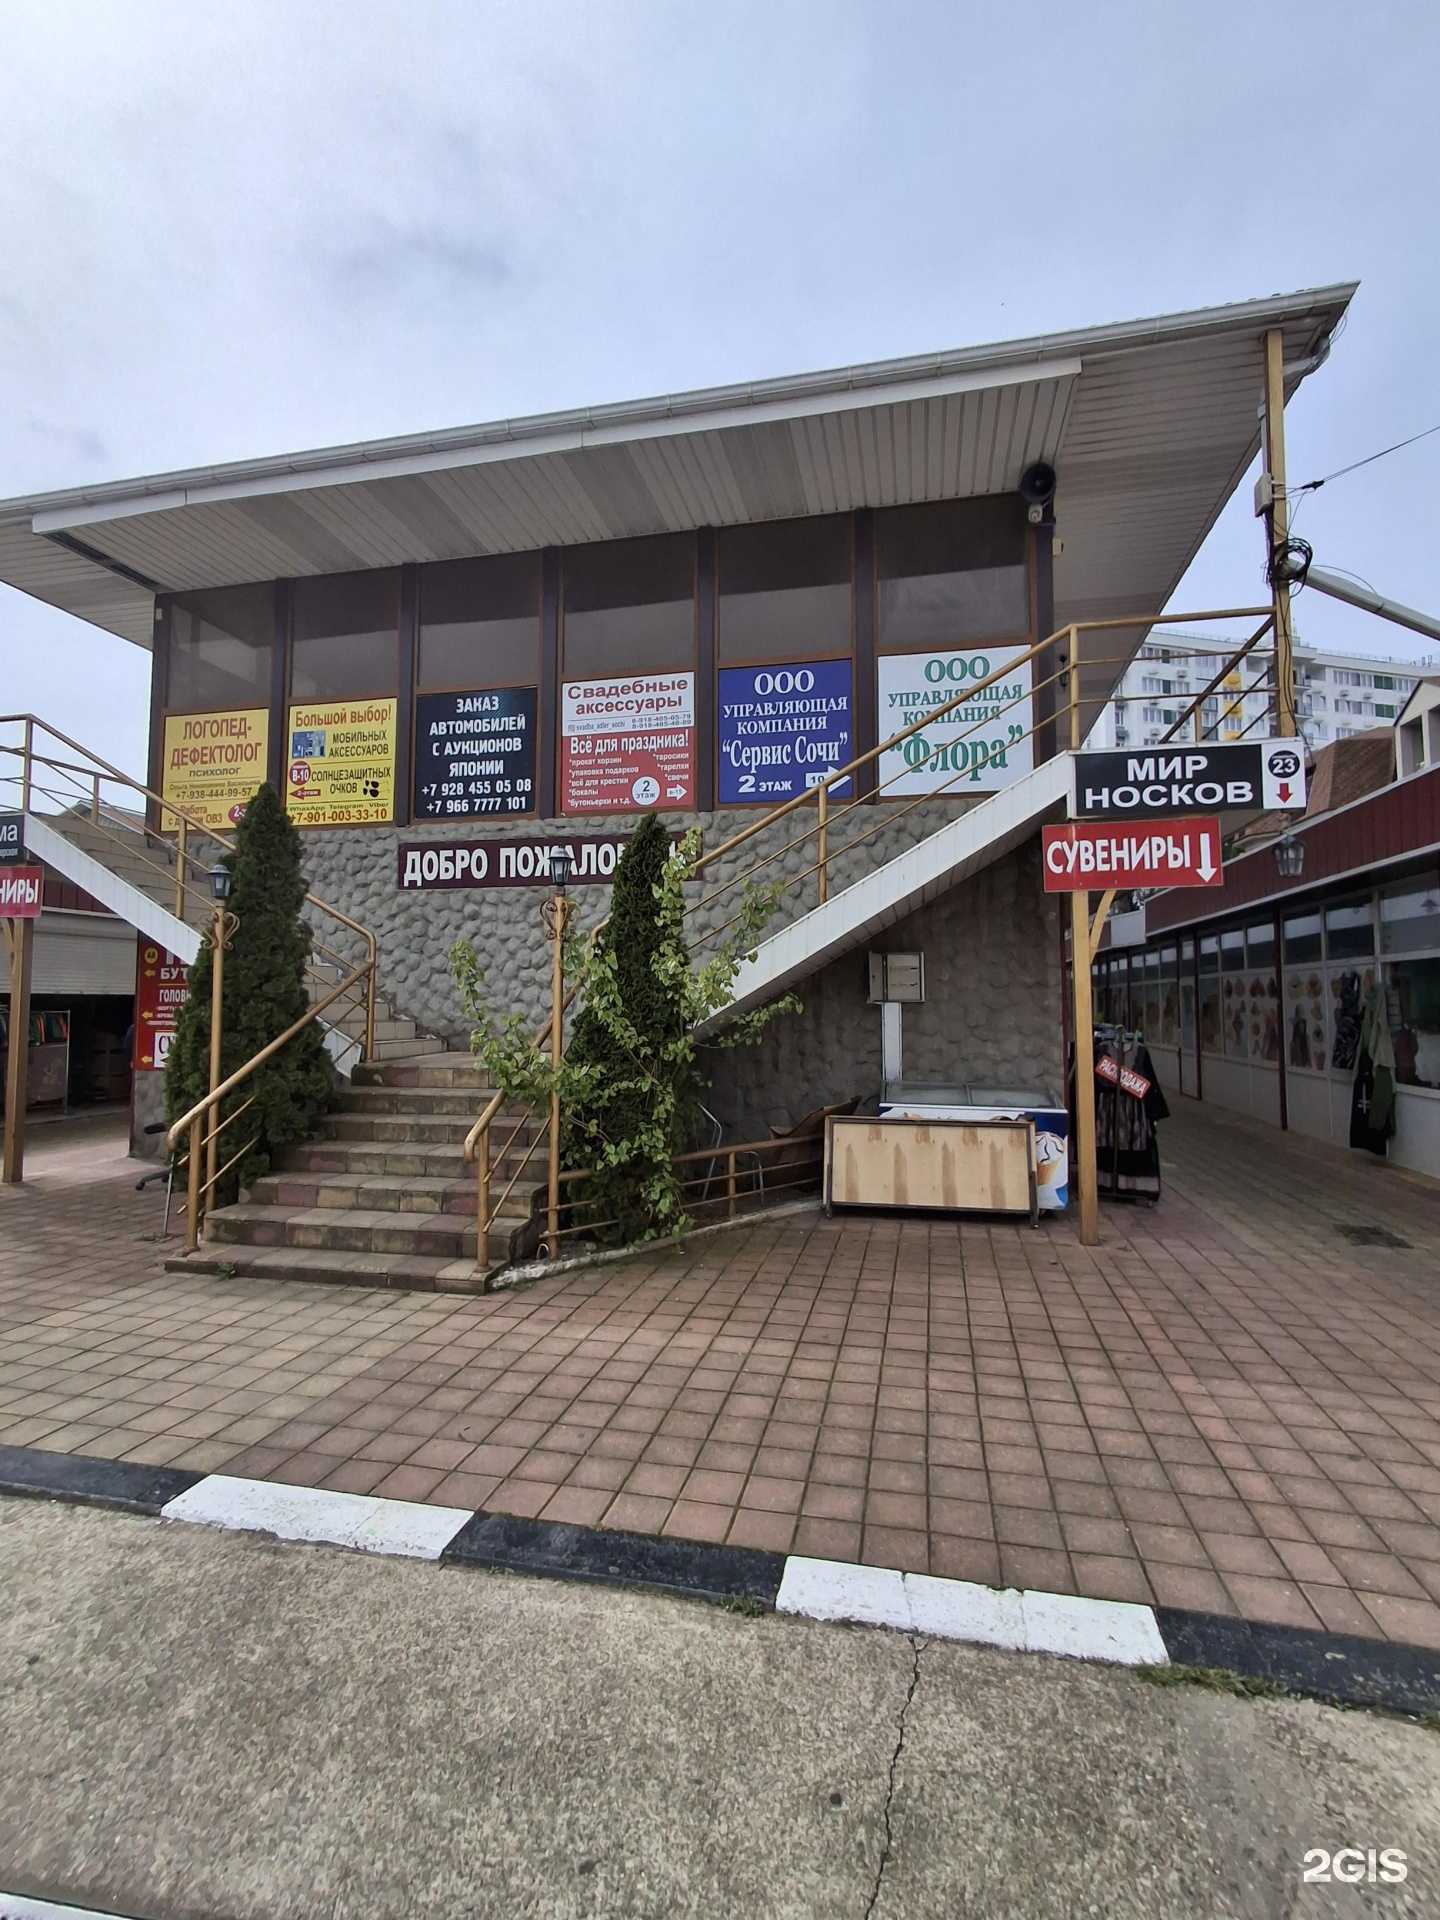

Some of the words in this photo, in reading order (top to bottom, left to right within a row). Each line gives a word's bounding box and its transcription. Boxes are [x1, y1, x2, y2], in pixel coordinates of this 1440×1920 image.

[924, 655, 990, 683] ООО
[567, 679, 688, 699] Свадебные
[754, 669, 814, 695] ООО
[456, 696, 499, 713] ЗАКАЗ
[575, 695, 682, 715] аксессуары
[723, 696, 847, 718] УПРАВЛЯЮЩАЯ
[295, 706, 347, 727] Большой
[350, 704, 392, 725] выбор!
[429, 713, 526, 736] АВТОМОБИЛЕЙ
[903, 705, 1001, 726] КОПАНИЯ
[183, 717, 252, 740] ЛОГОПЕД-
[737, 716, 827, 735] КОМПАНИЯ
[332, 730, 388, 744] МОБИЛЬНЫХ
[570, 736, 592, 754] Всё
[595, 740, 618, 755] для
[621, 729, 689, 755] праздника!
[171, 742, 262, 769] ДЕФЕКТОЛОГ
[328, 744, 389, 758] АКСЕССУАРОВ
[432, 743, 440, 756] С
[444, 738, 522, 756] АУКЦИОНОВ
[189, 767, 241, 777] психолог
[311, 767, 391, 782] СОЛНЦЕЗАЩИТНЫХ
[449, 760, 504, 777] ЯПОНИИ
[1127, 755, 1208, 782] МИР
[1272, 758, 1295, 773] 23
[176, 787, 253, 799] +7-938-444-99-57
[329, 782, 358, 794] ОЧКОВ
[422, 784, 437, 796] +7
[442, 783, 464, 796] 928
[469, 781, 491, 794] 455
[496, 780, 512, 793] 05
[516, 779, 532, 792] 08
[642, 780, 650, 792] 2
[738, 775, 756, 793] 2
[427, 801, 442, 813] +7
[446, 800, 469, 813] 966
[474, 798, 502, 811] 7777
[506, 796, 526, 810] 101
[1085, 781, 1254, 809] НОСКОВ
[290, 808, 387, 823] +7-901-003-33-10
[403, 848, 488, 887] ДОБРО
[500, 840, 687, 878] ПОЖАЛО
[1046, 834, 1191, 874] СУВЕНИРЫ
